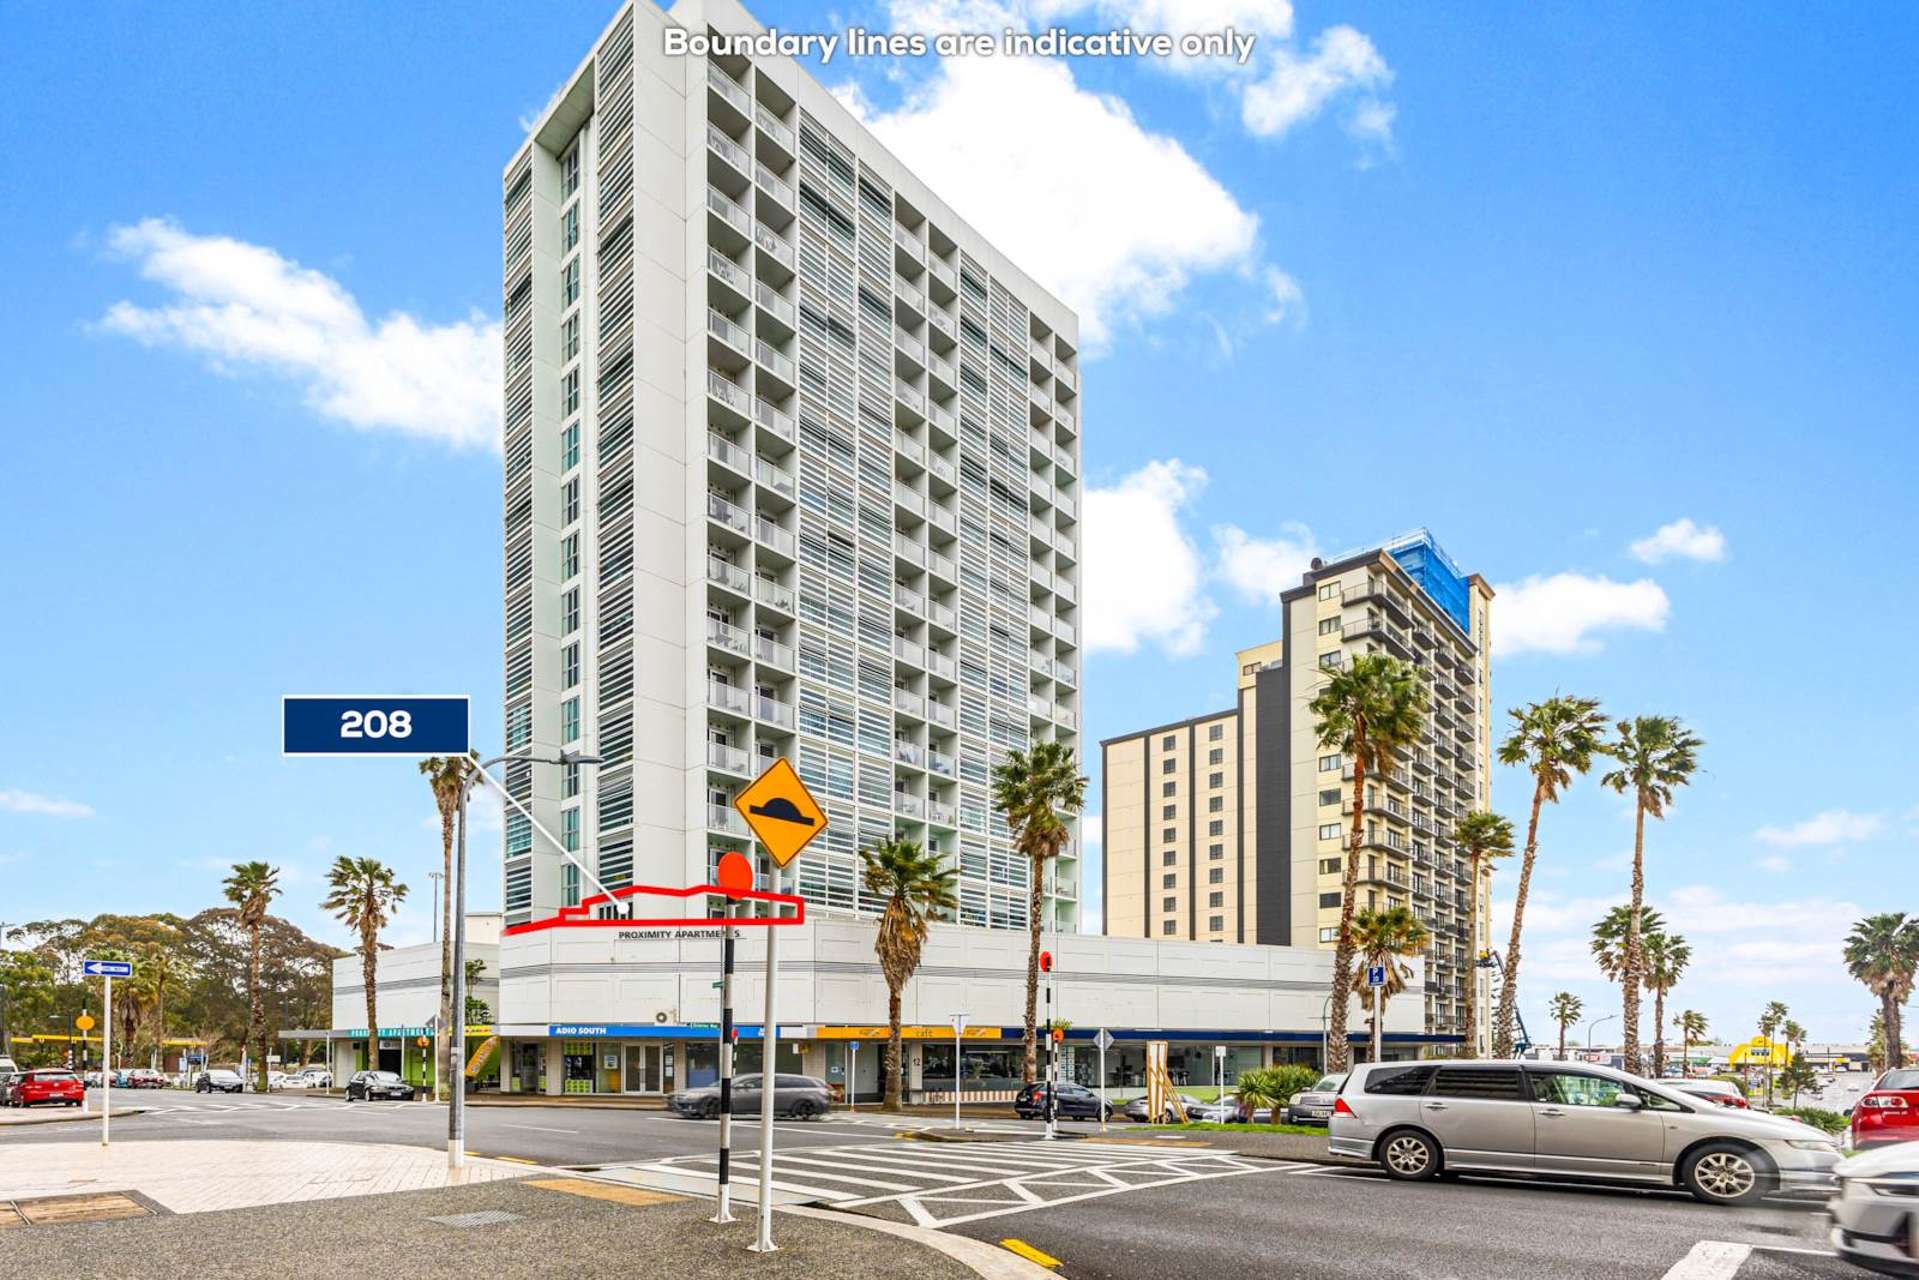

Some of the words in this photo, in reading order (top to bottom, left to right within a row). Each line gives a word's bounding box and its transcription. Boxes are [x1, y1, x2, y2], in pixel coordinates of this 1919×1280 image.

[618, 930, 671, 939] PROXIMITY
[674, 929, 740, 938] APARTMES
[556, 1027, 577, 1035] ADIO
[578, 1027, 607, 1035] SOUTH
